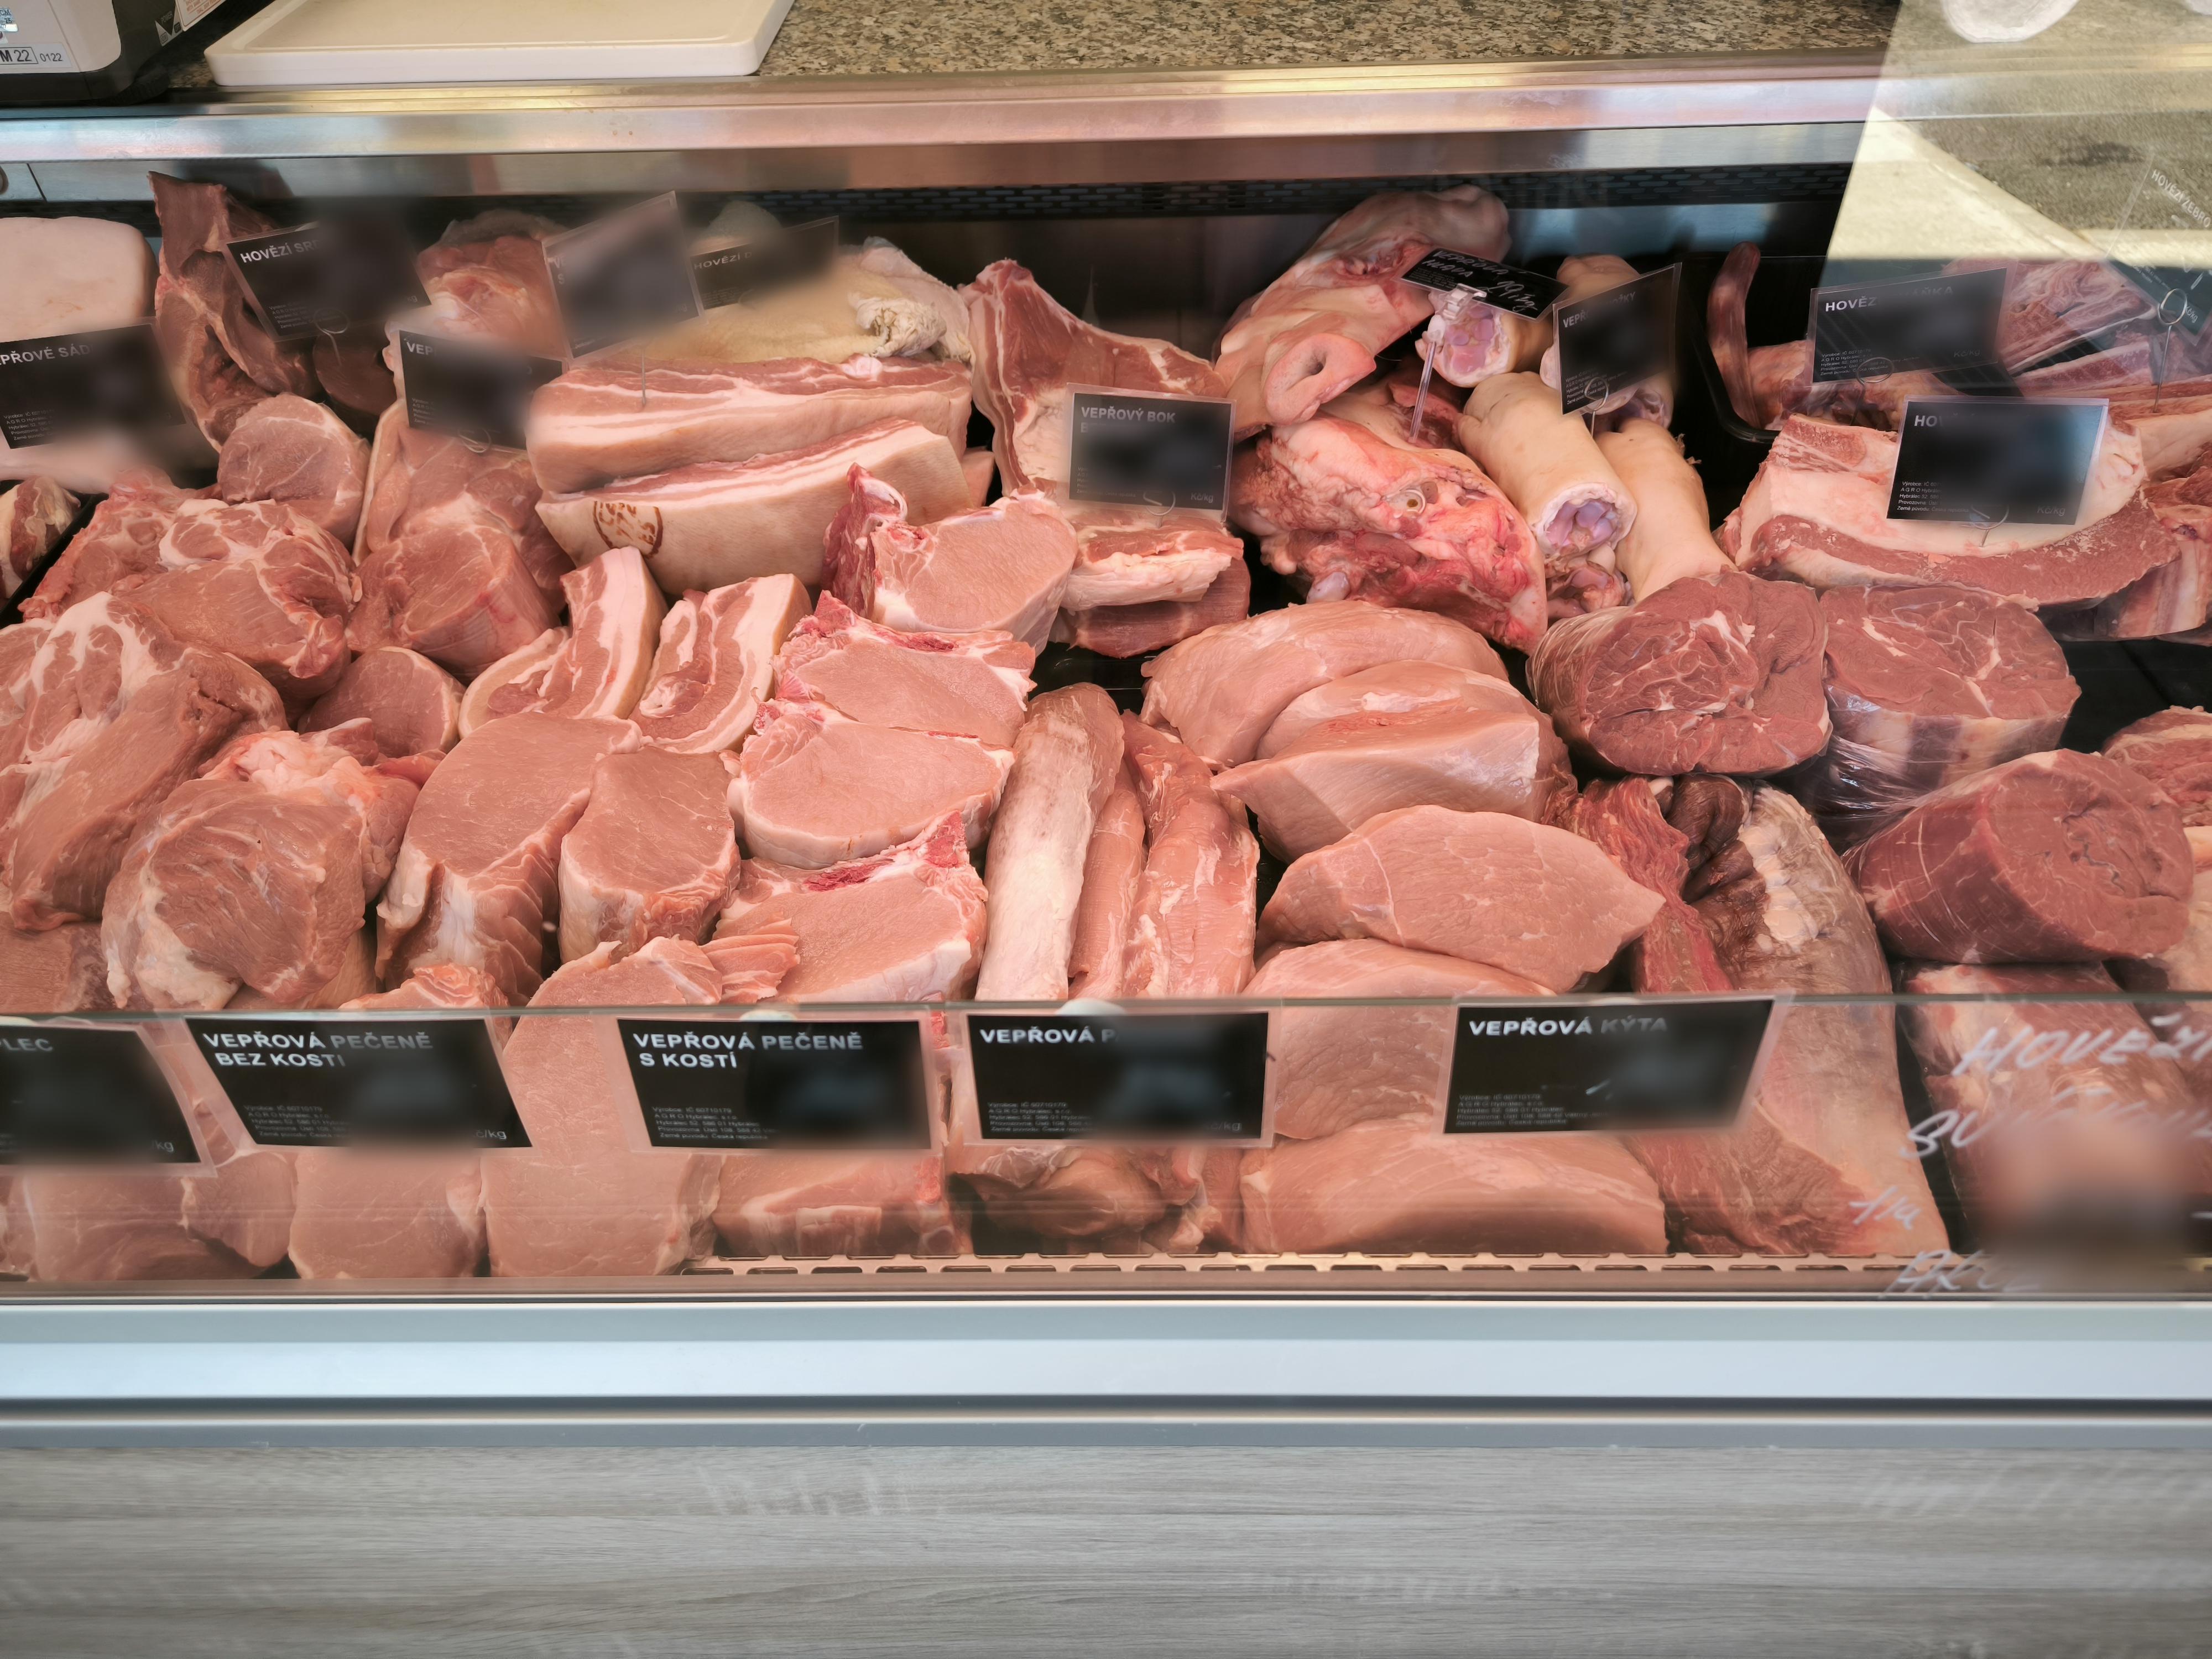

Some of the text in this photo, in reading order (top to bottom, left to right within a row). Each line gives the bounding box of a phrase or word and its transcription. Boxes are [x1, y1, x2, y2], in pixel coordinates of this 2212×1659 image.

[14, 50, 32, 62] 22
[39, 53, 62, 62] 0122
[240, 243, 293, 264] HOVĚZÍ
[694, 252, 740, 270] HOVĚZÍ
[1825, 295, 1877, 312] HOVĚZ
[0, 343, 92, 366] PŘOVÉ SÁD
[406, 341, 434, 356] VEP
[1081, 406, 1176, 423] VEPŘOVÝ BOK
[2037, 505, 2065, 516] Kč/kg
[1469, 1015, 1667, 1036] VEPŘOVÁ KÝTA
[202, 1031, 434, 1050] VEPŘOVÁ PEČENĚ
[633, 1031, 863, 1050] VEPŘOVÁ PEČENĚ
[980, 1026, 1095, 1044] VEPŘOVÁ
[0, 1038, 53, 1051] LEC
[215, 1053, 346, 1067] BEZ KOSTI
[640, 1051, 737, 1068] S KOSTÍ
[476, 1129, 507, 1140] č/kg
[1209, 1121, 1243, 1132] č/kg
[153, 1140, 174, 1152] /kg
